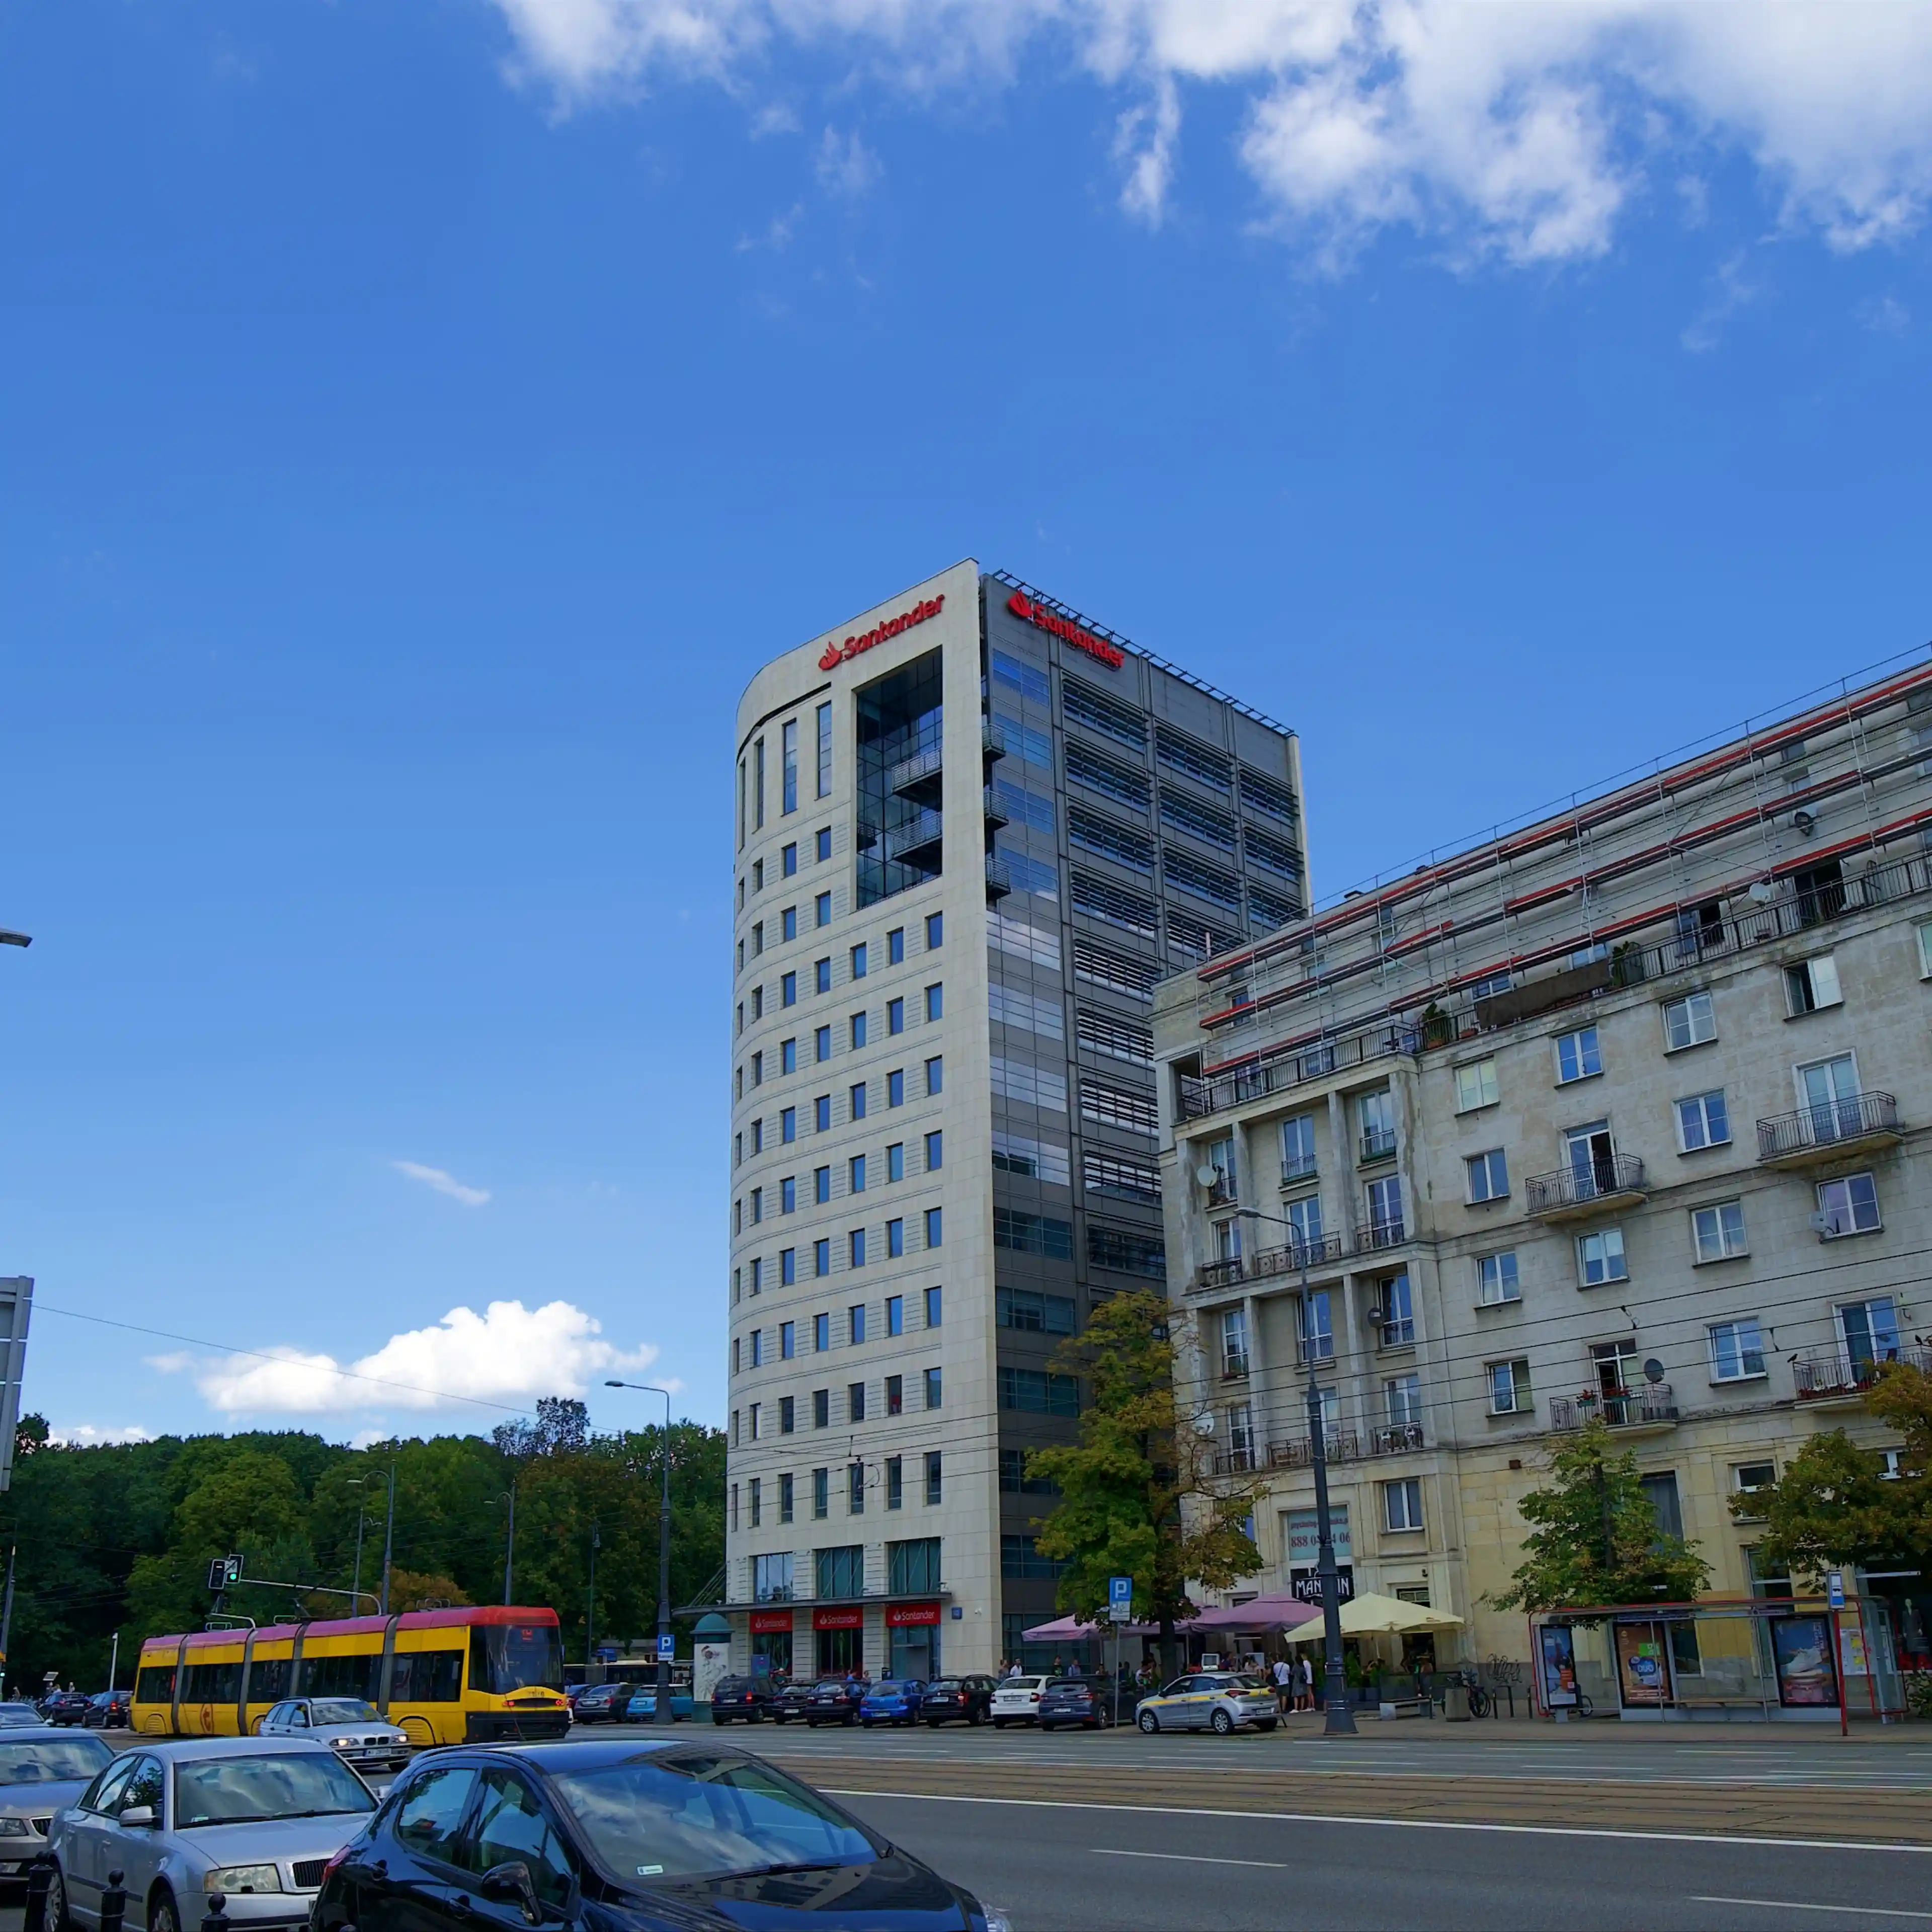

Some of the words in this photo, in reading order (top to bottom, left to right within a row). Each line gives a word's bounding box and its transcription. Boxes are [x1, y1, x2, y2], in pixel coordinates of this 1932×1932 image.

[844, 594, 945, 659] Santander
[1034, 603, 1124, 667] Santander
[1291, 1536, 1308, 1547] 888
[1339, 1532, 1350, 1543] 06
[1115, 1580, 1127, 1598] P
[827, 1614, 858, 1624] Santander
[901, 1609, 935, 1621] Santander
[762, 1619, 788, 1628] Santander
[661, 1637, 671, 1651] P
